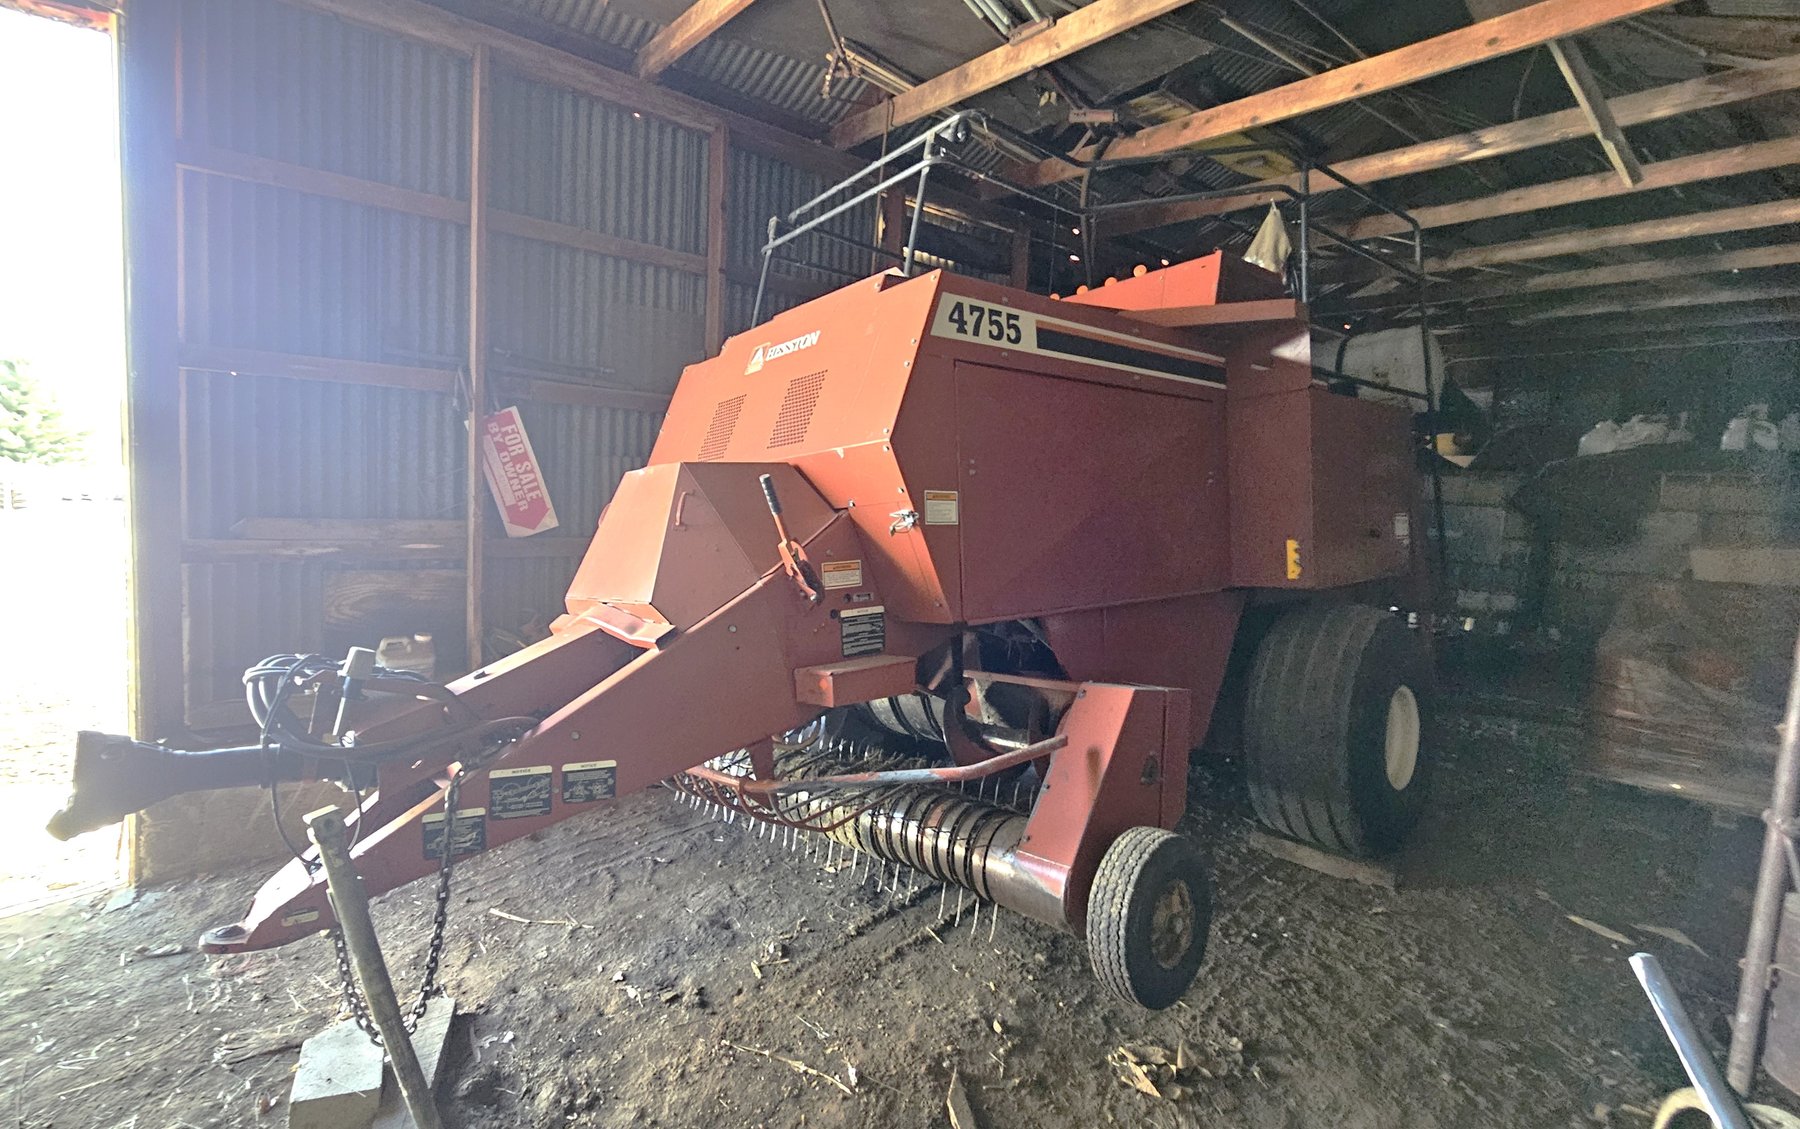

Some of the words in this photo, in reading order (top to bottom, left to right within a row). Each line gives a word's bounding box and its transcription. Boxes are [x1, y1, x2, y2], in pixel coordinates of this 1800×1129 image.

[947, 302, 1022, 345] 4755
[487, 423, 503, 443] BY
[500, 451, 529, 511] OWNER
[500, 424, 526, 456] FOR
[515, 461, 542, 502] SALE
